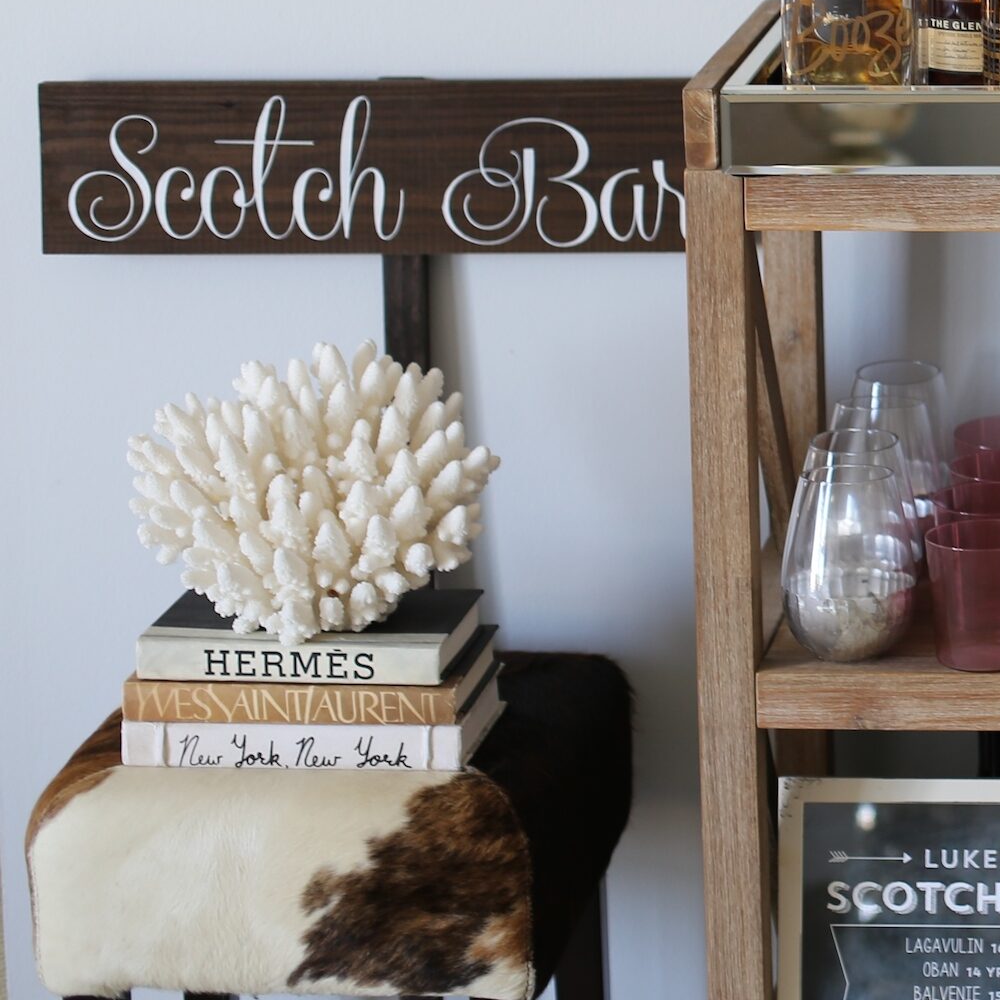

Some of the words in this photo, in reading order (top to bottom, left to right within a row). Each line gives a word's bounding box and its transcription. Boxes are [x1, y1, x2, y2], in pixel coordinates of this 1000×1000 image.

[930, 18, 949, 29] THE
[67, 95, 405, 242] Scotch
[441, 117, 686, 248] Bar
[179, 734, 224, 768] New
[295, 736, 342, 768] New
[354, 736, 413, 769] York
[905, 937, 984, 954] LAGAVULIN
[922, 961, 960, 978] OBAN
[965, 966, 982, 978] 14
[913, 985, 981, 1000] BALVENIE
